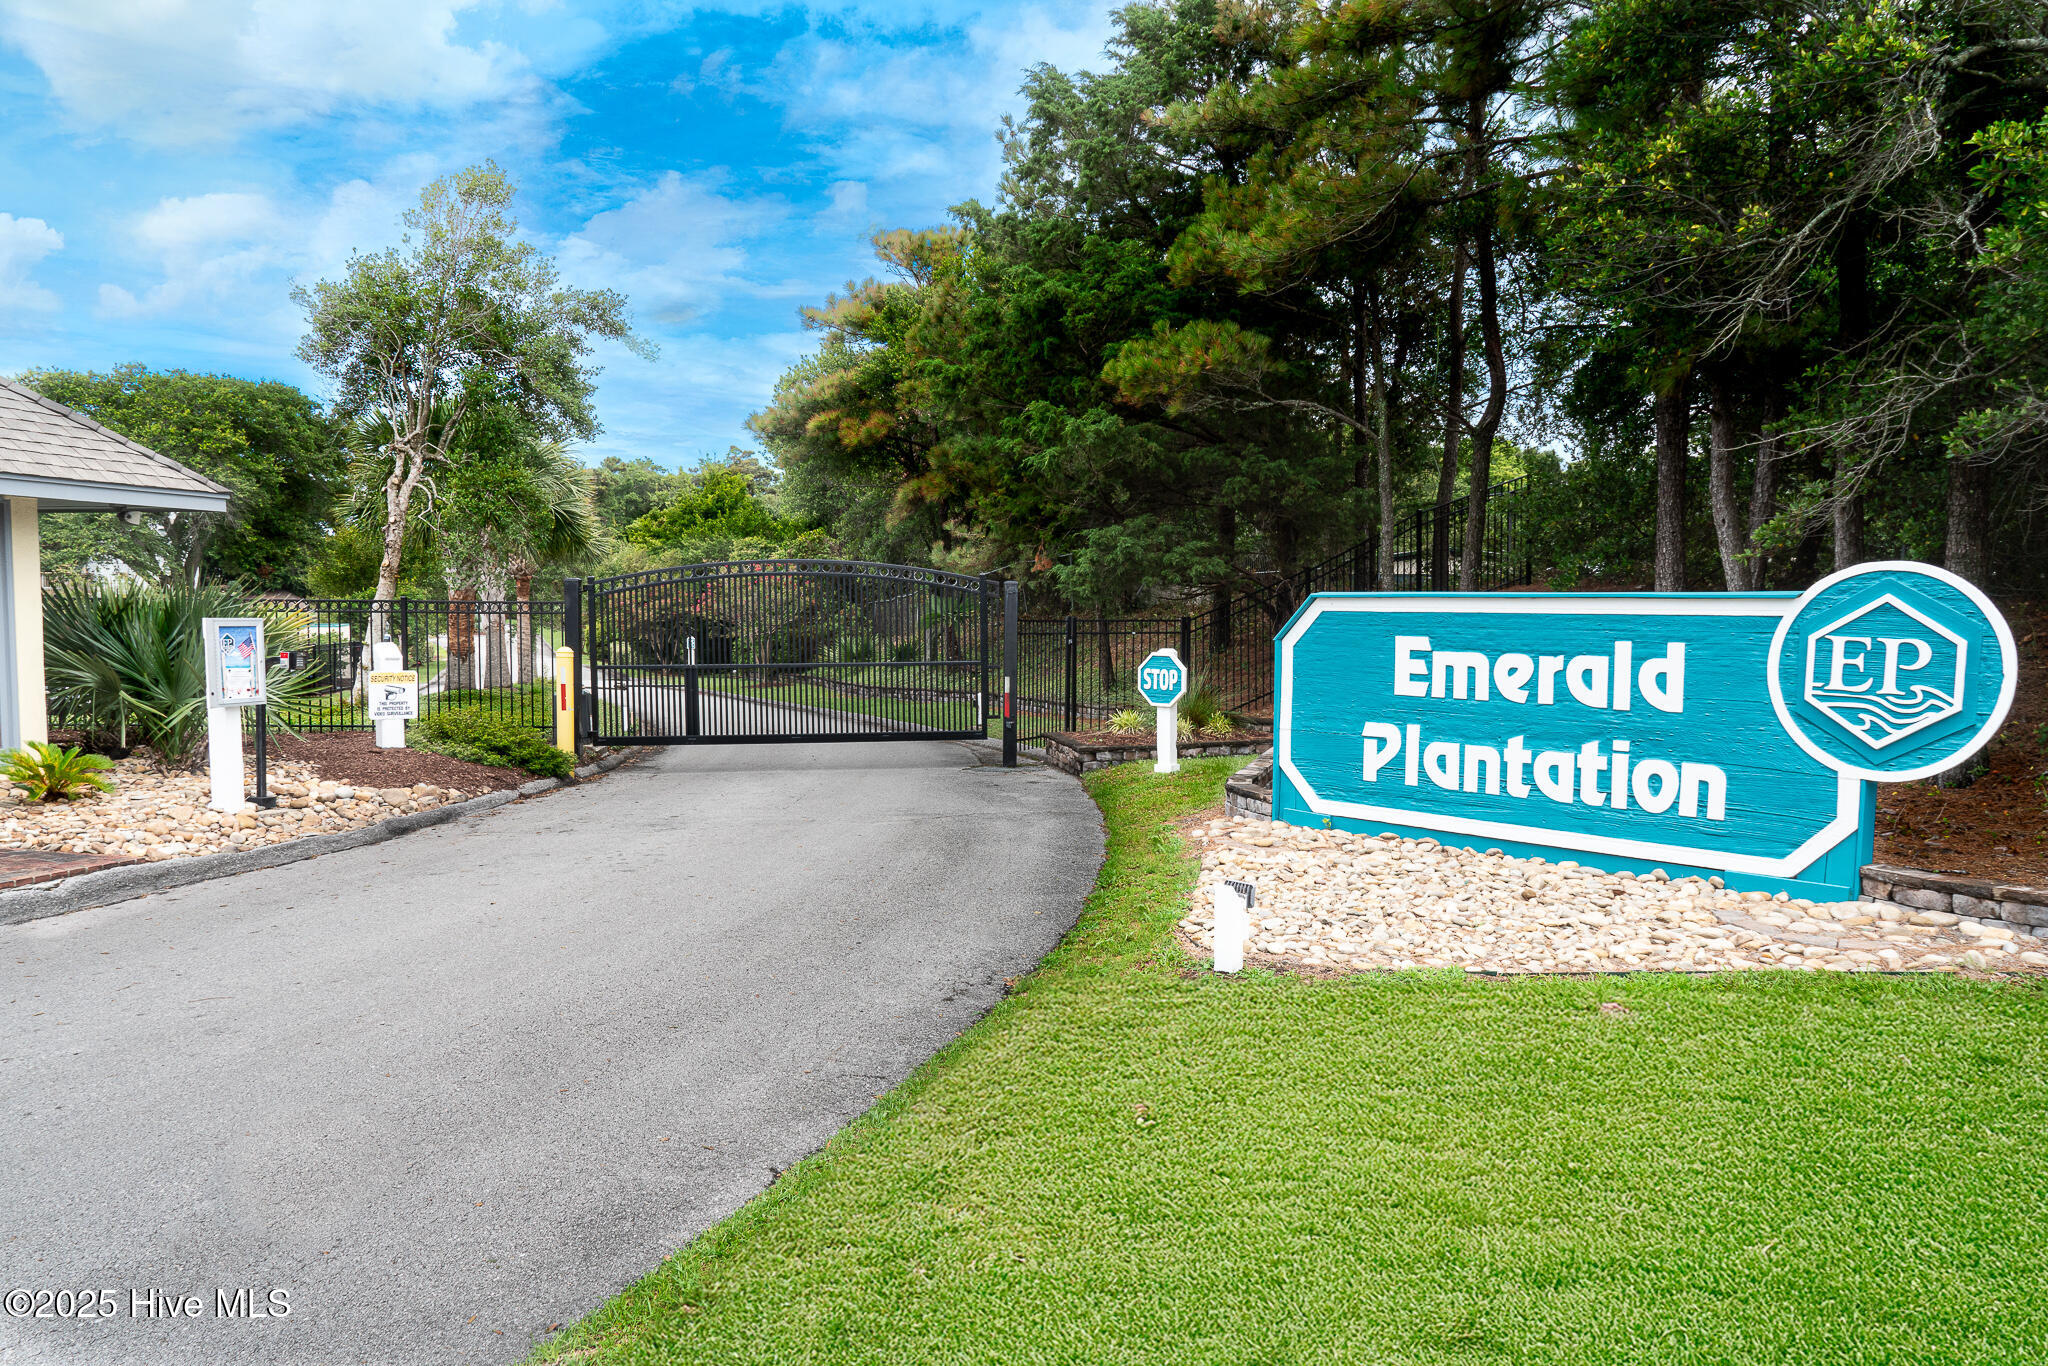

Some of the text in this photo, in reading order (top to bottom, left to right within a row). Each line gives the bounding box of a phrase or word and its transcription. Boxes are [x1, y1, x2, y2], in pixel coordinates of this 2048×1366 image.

[370, 674, 416, 683] SECURITY NOTICE
[1143, 668, 1178, 691] STOP
[1393, 635, 1686, 713] Emerald
[1824, 635, 1933, 695] EP
[1361, 721, 1727, 821] Plantation
